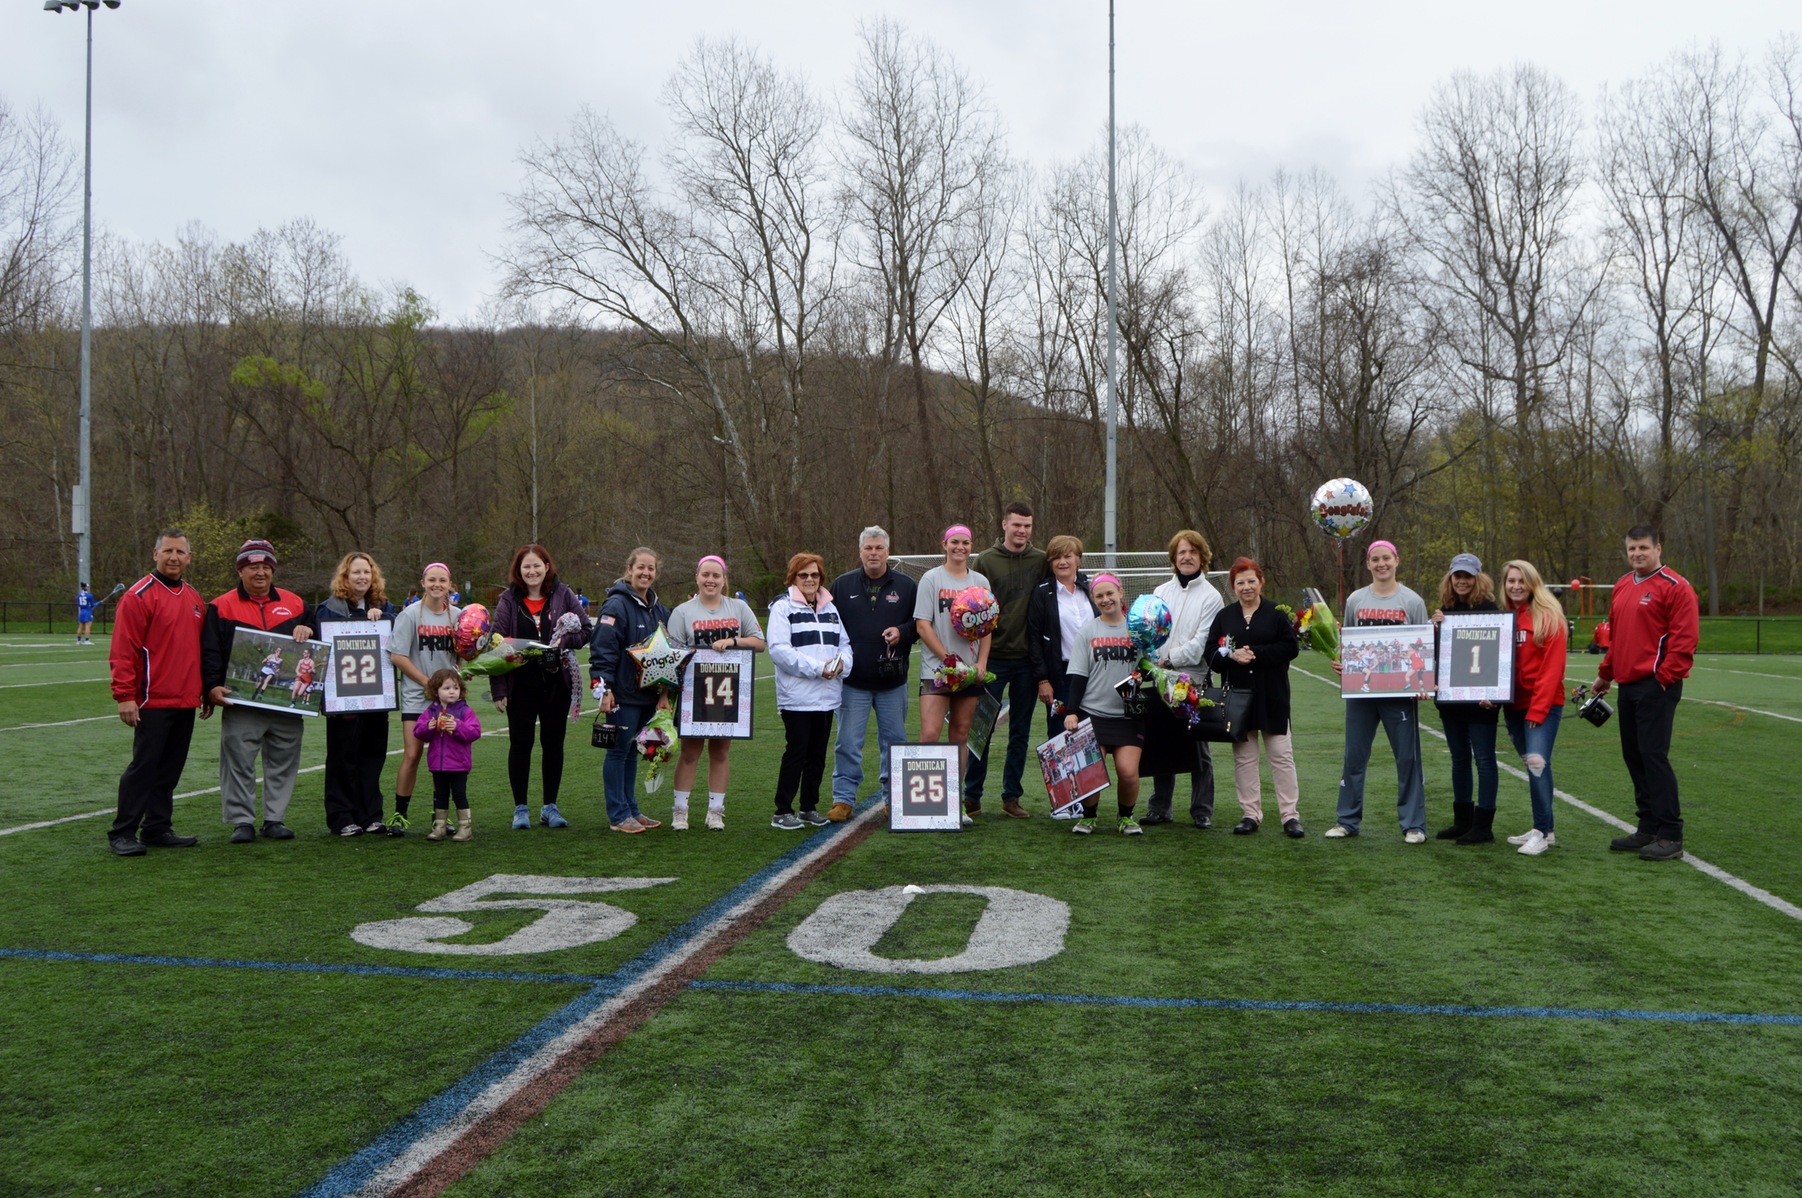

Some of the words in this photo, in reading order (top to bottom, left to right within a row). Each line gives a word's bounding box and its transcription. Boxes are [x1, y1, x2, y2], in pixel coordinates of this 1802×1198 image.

[1357, 608, 1407, 622] CHARGER
[417, 624, 454, 637] CHARG
[692, 617, 740, 631] CHARGER
[1456, 628, 1497, 641] DOMINICAN
[336, 639, 377, 651] DOMINICAN
[418, 635, 455, 652] PRID
[1091, 637, 1135, 649] CHARGE
[641, 650, 682, 669] Congrats
[1470, 644, 1482, 675] 1
[340, 653, 378, 685] 22
[700, 662, 739, 674] DOMINICAN
[704, 675, 735, 707] 14
[1400, 711, 1408, 721] 1
[907, 760, 946, 772] DOMINICAN
[909, 774, 945, 804] 25
